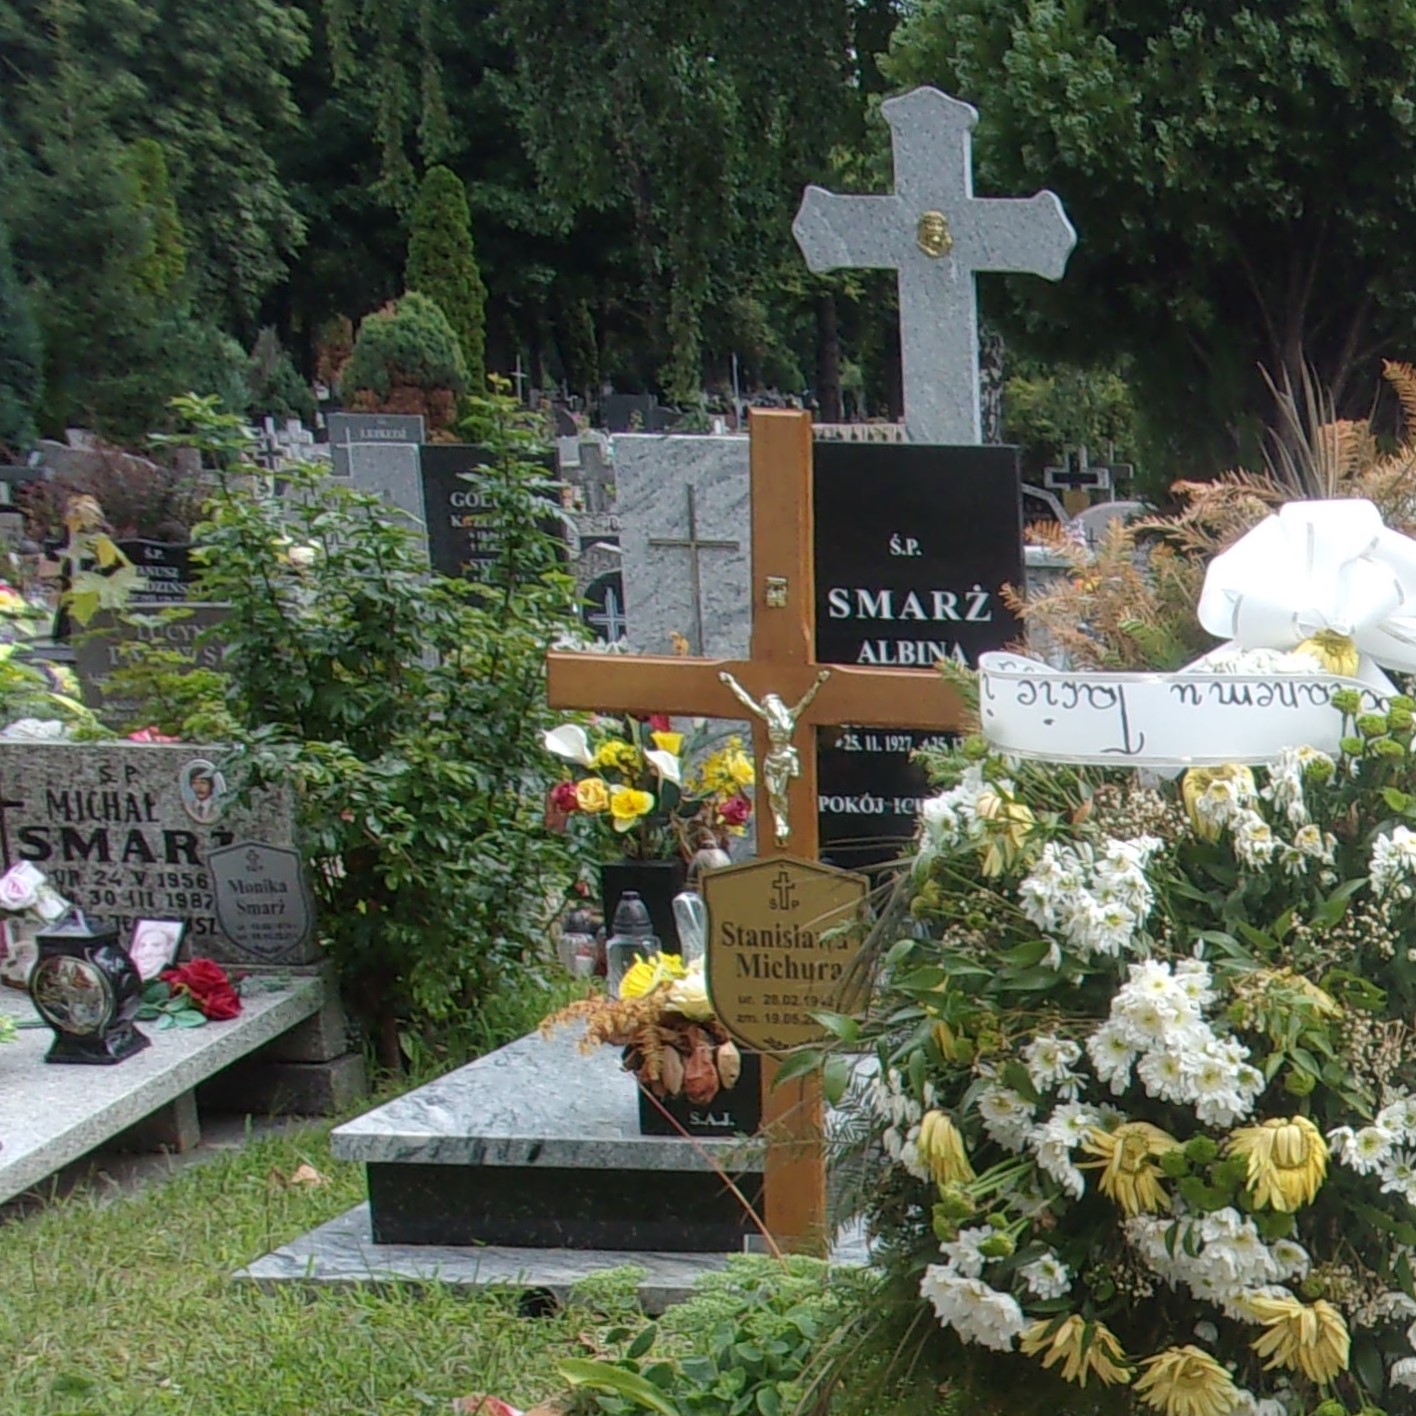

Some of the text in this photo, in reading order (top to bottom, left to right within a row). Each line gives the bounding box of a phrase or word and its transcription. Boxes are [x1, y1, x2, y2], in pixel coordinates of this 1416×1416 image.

[889, 533, 923, 556] Ś.P.
[828, 583, 993, 622] SMARŻ
[856, 639, 970, 666] ALBINA
[1017, 680, 1144, 755] Tacie
[46, 789, 160, 823] MICHAŁ
[819, 792, 885, 814] POKÓJ
[157, 871, 209, 889] 1956
[228, 879, 288, 895] Monika
[166, 891, 214, 910] 1987
[736, 953, 843, 981] Michura
